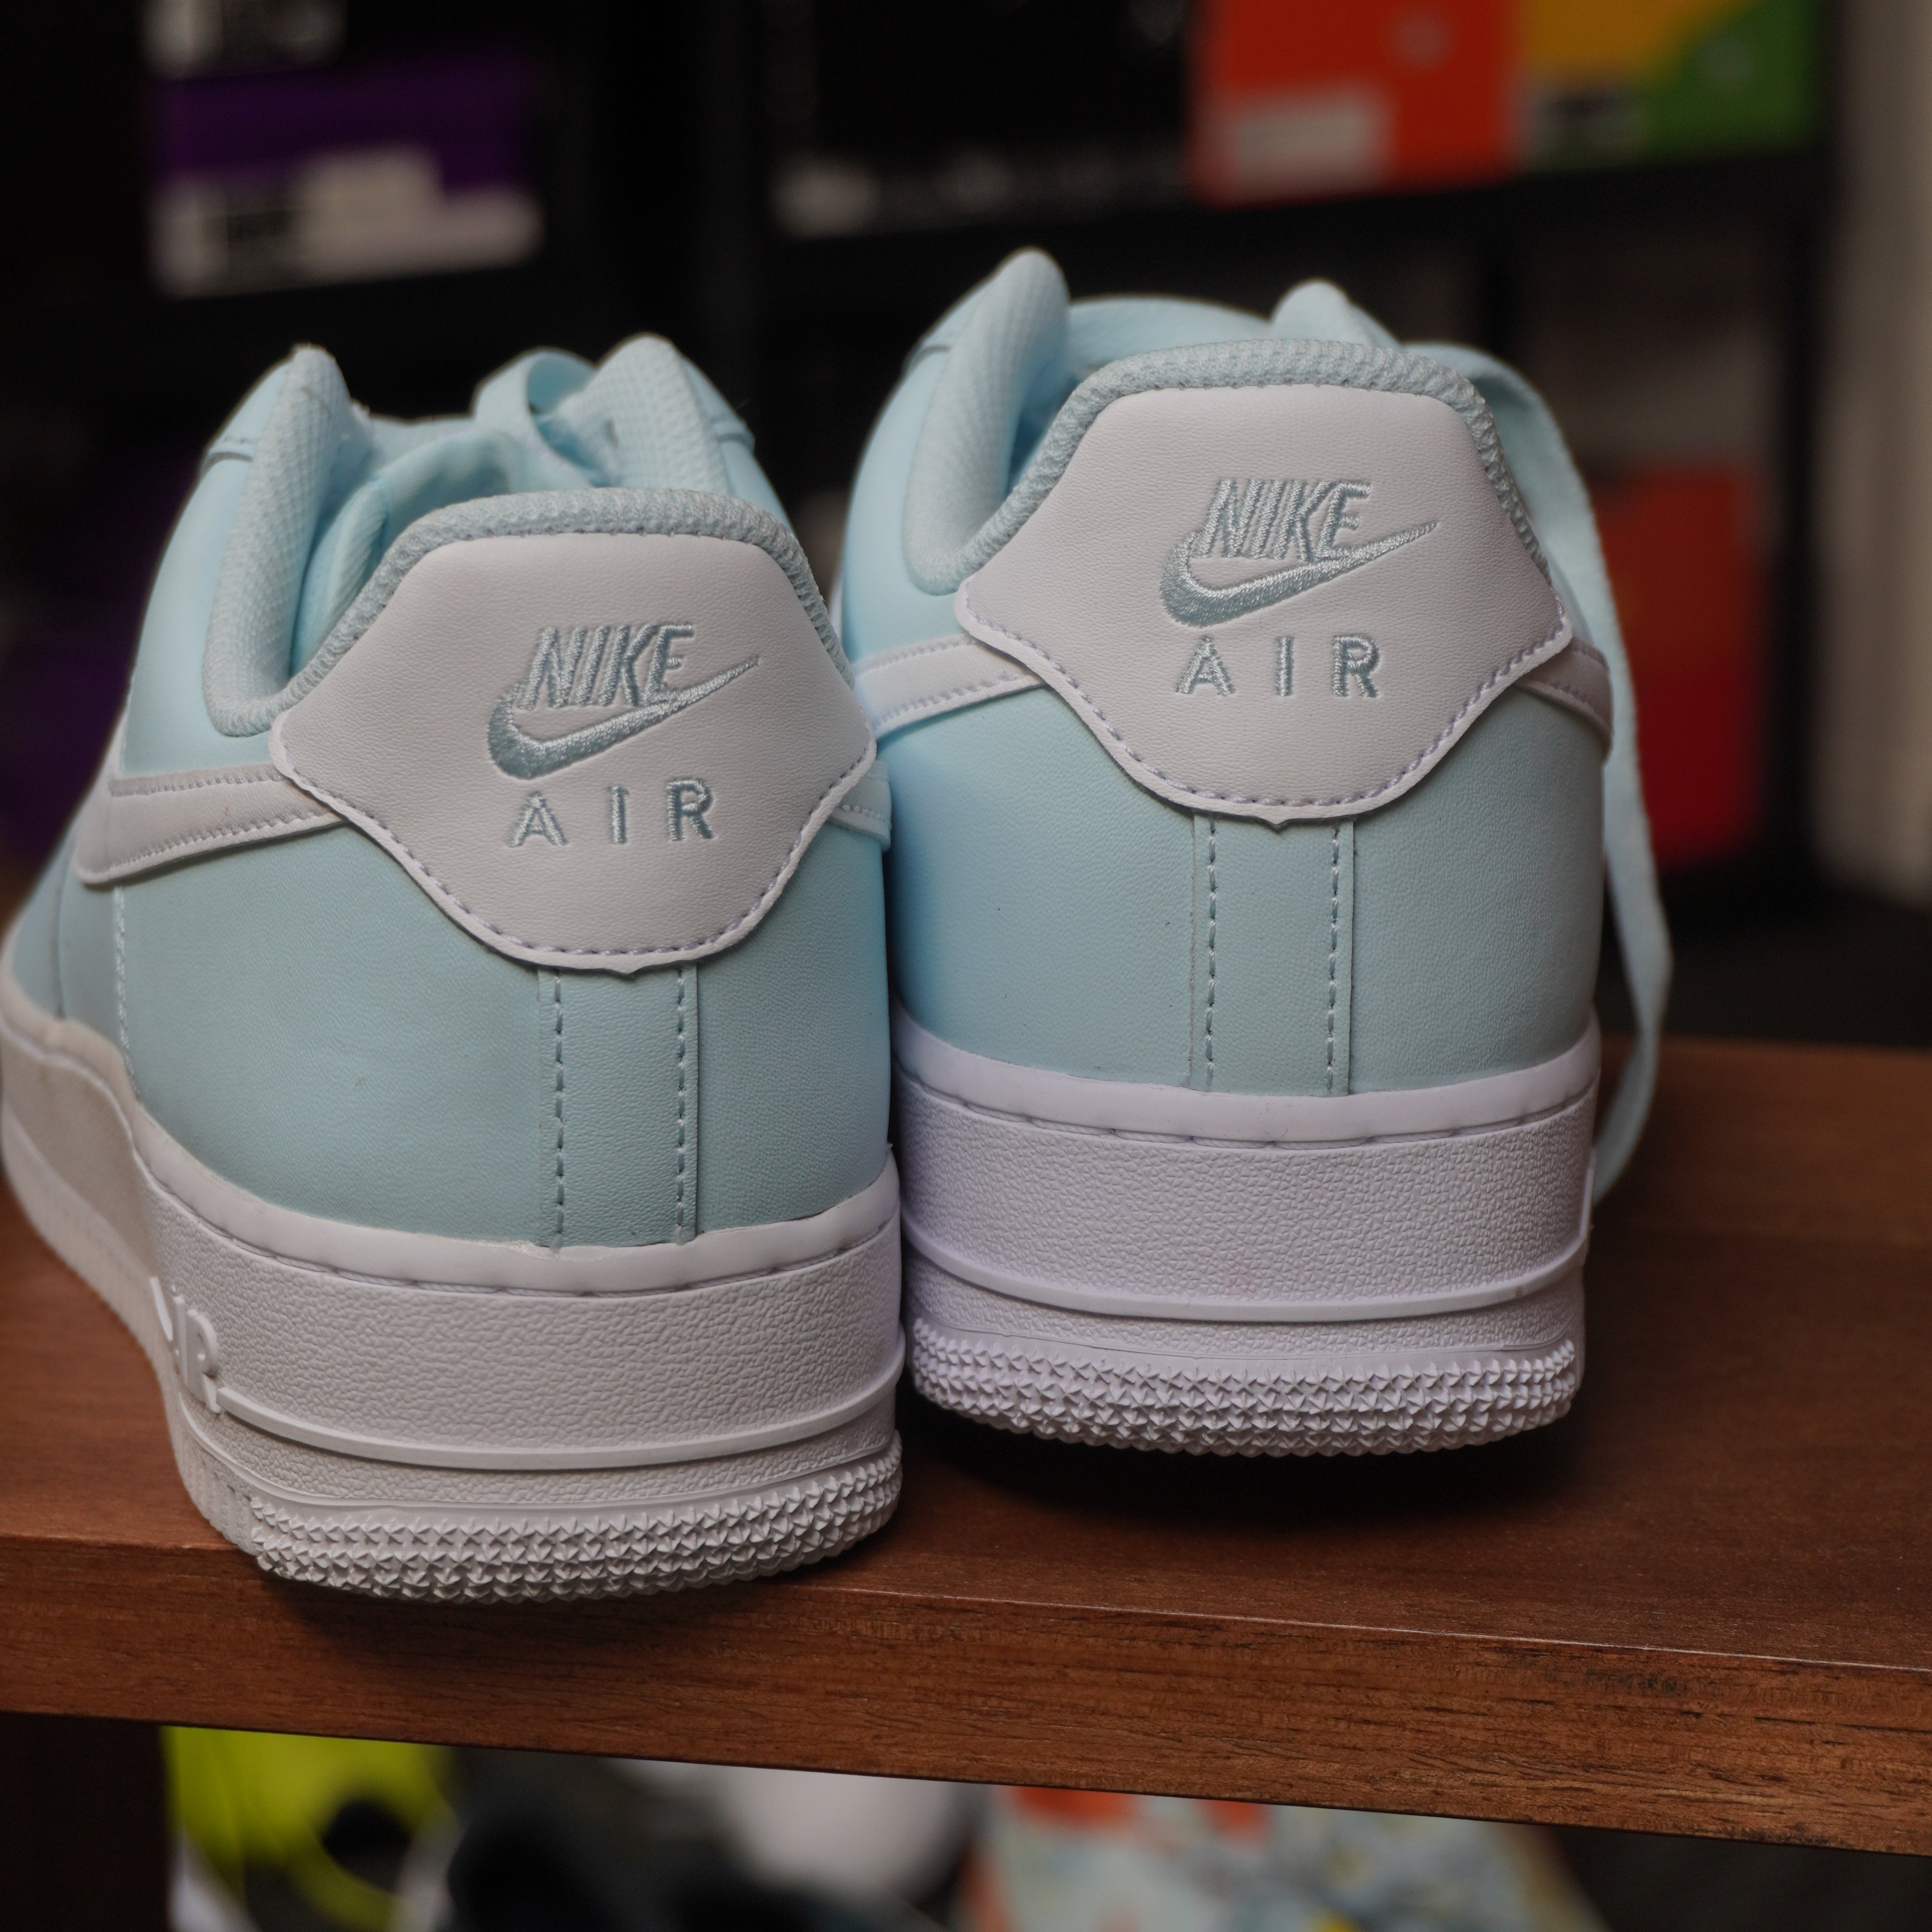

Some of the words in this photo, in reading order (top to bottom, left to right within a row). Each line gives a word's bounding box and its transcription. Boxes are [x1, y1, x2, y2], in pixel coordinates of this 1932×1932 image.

[1193, 479, 1373, 560] NIKE
[517, 622, 695, 709] NIKE
[1175, 635, 1381, 697] AIR
[506, 778, 716, 847] AIR
